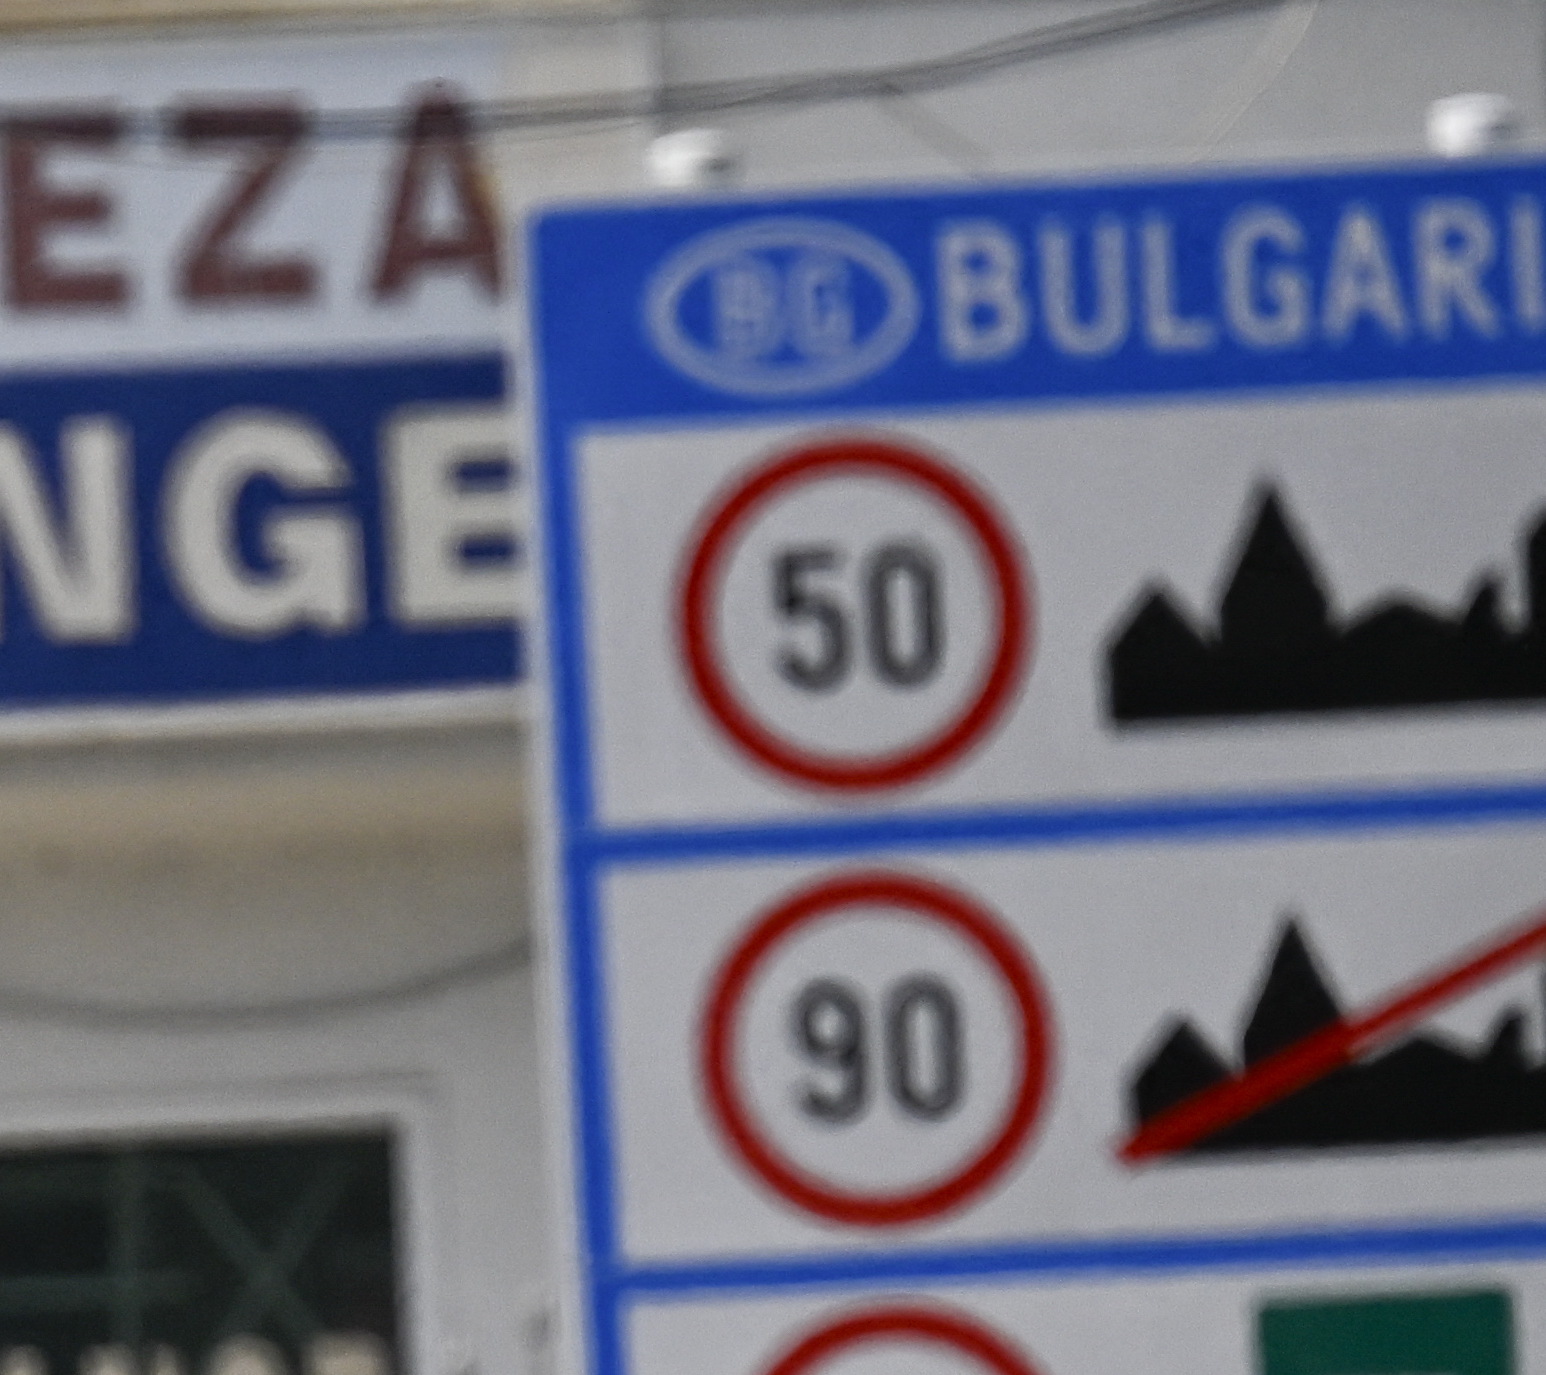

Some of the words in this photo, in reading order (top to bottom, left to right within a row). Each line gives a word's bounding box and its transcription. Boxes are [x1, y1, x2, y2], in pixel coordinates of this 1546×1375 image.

[712, 245, 859, 358] BG
[768, 535, 950, 694] 50
[788, 970, 969, 1126] 90
